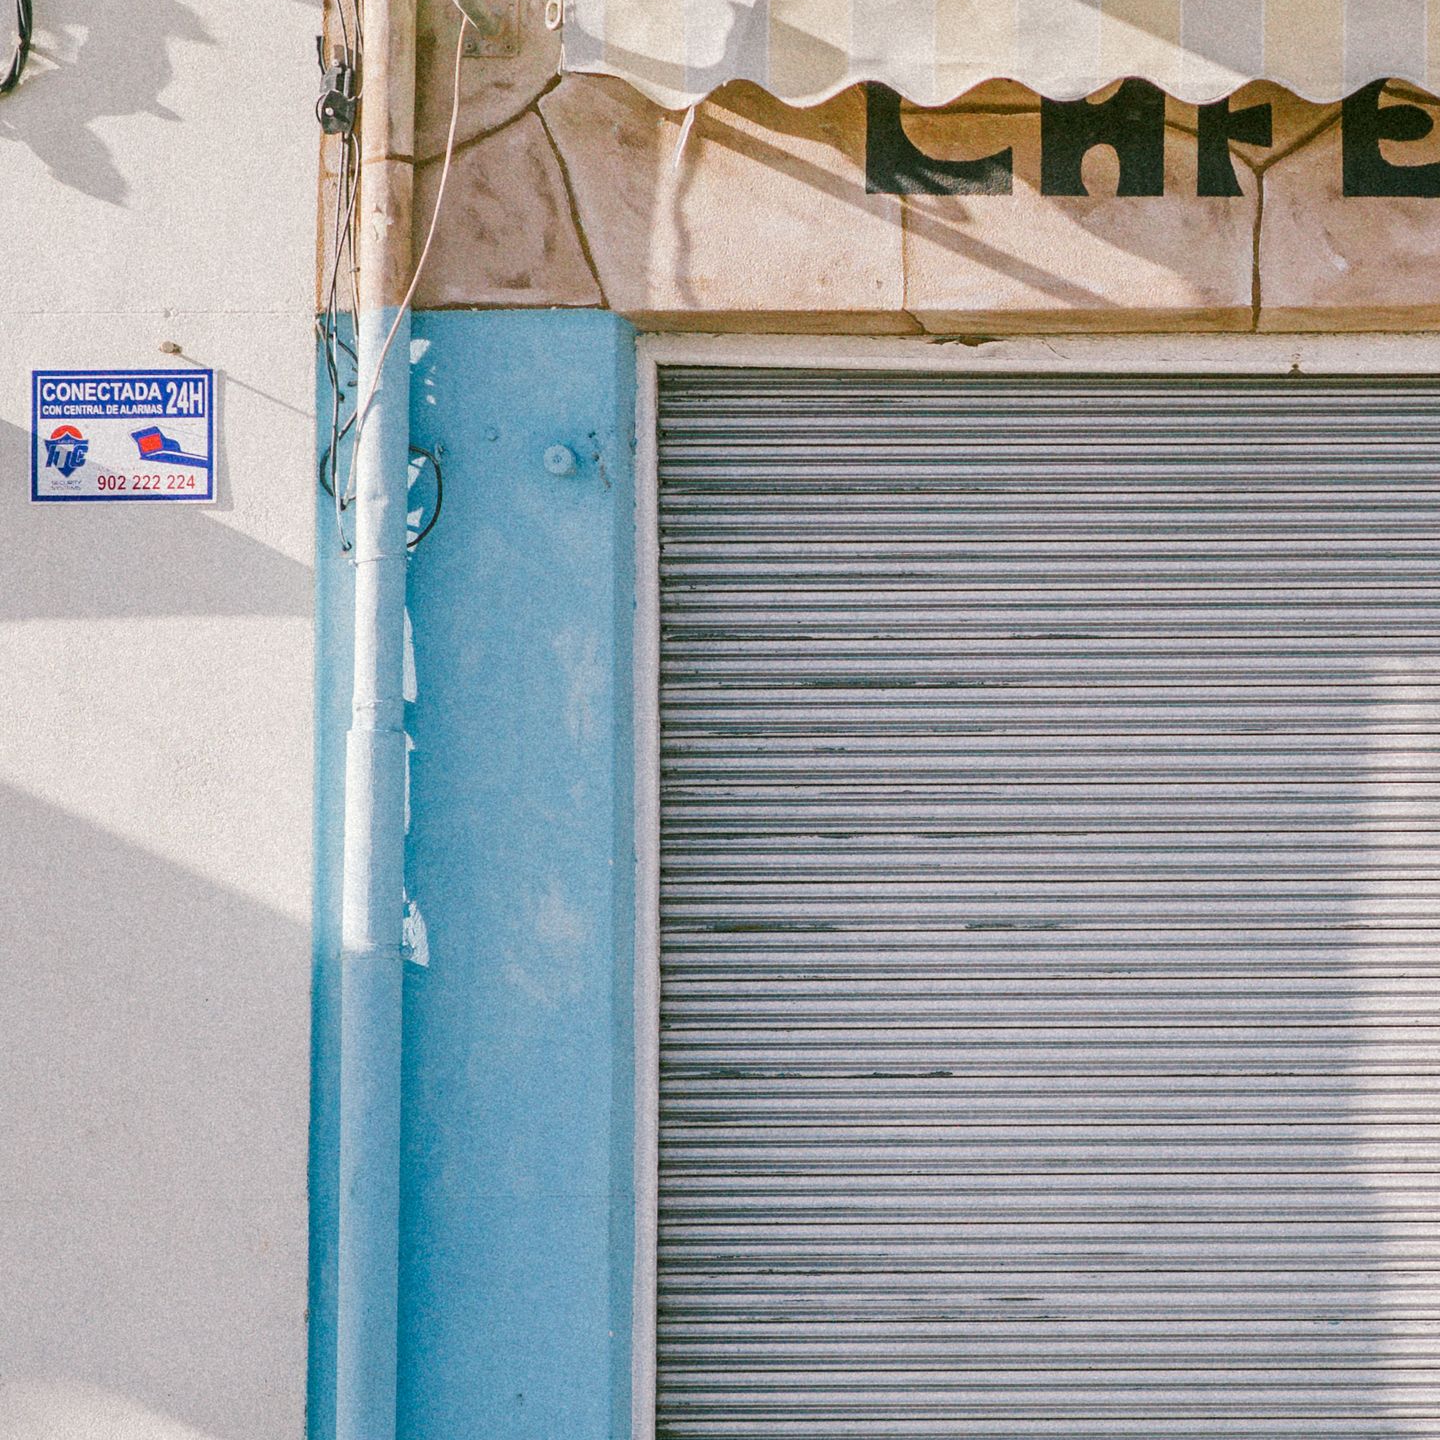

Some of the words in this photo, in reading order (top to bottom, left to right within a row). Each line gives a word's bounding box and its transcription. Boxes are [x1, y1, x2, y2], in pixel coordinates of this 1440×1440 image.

[42, 382, 163, 402] CONECTADA
[165, 381, 203, 415] 24H
[42, 404, 62, 416] CON
[63, 404, 105, 415] CENTRAL
[106, 404, 119, 415] DE
[119, 403, 164, 415] ALARMAS
[45, 443, 89, 468] ITC
[97, 475, 127, 491] 902
[132, 474, 161, 490] 222
[166, 474, 196, 490] 224
